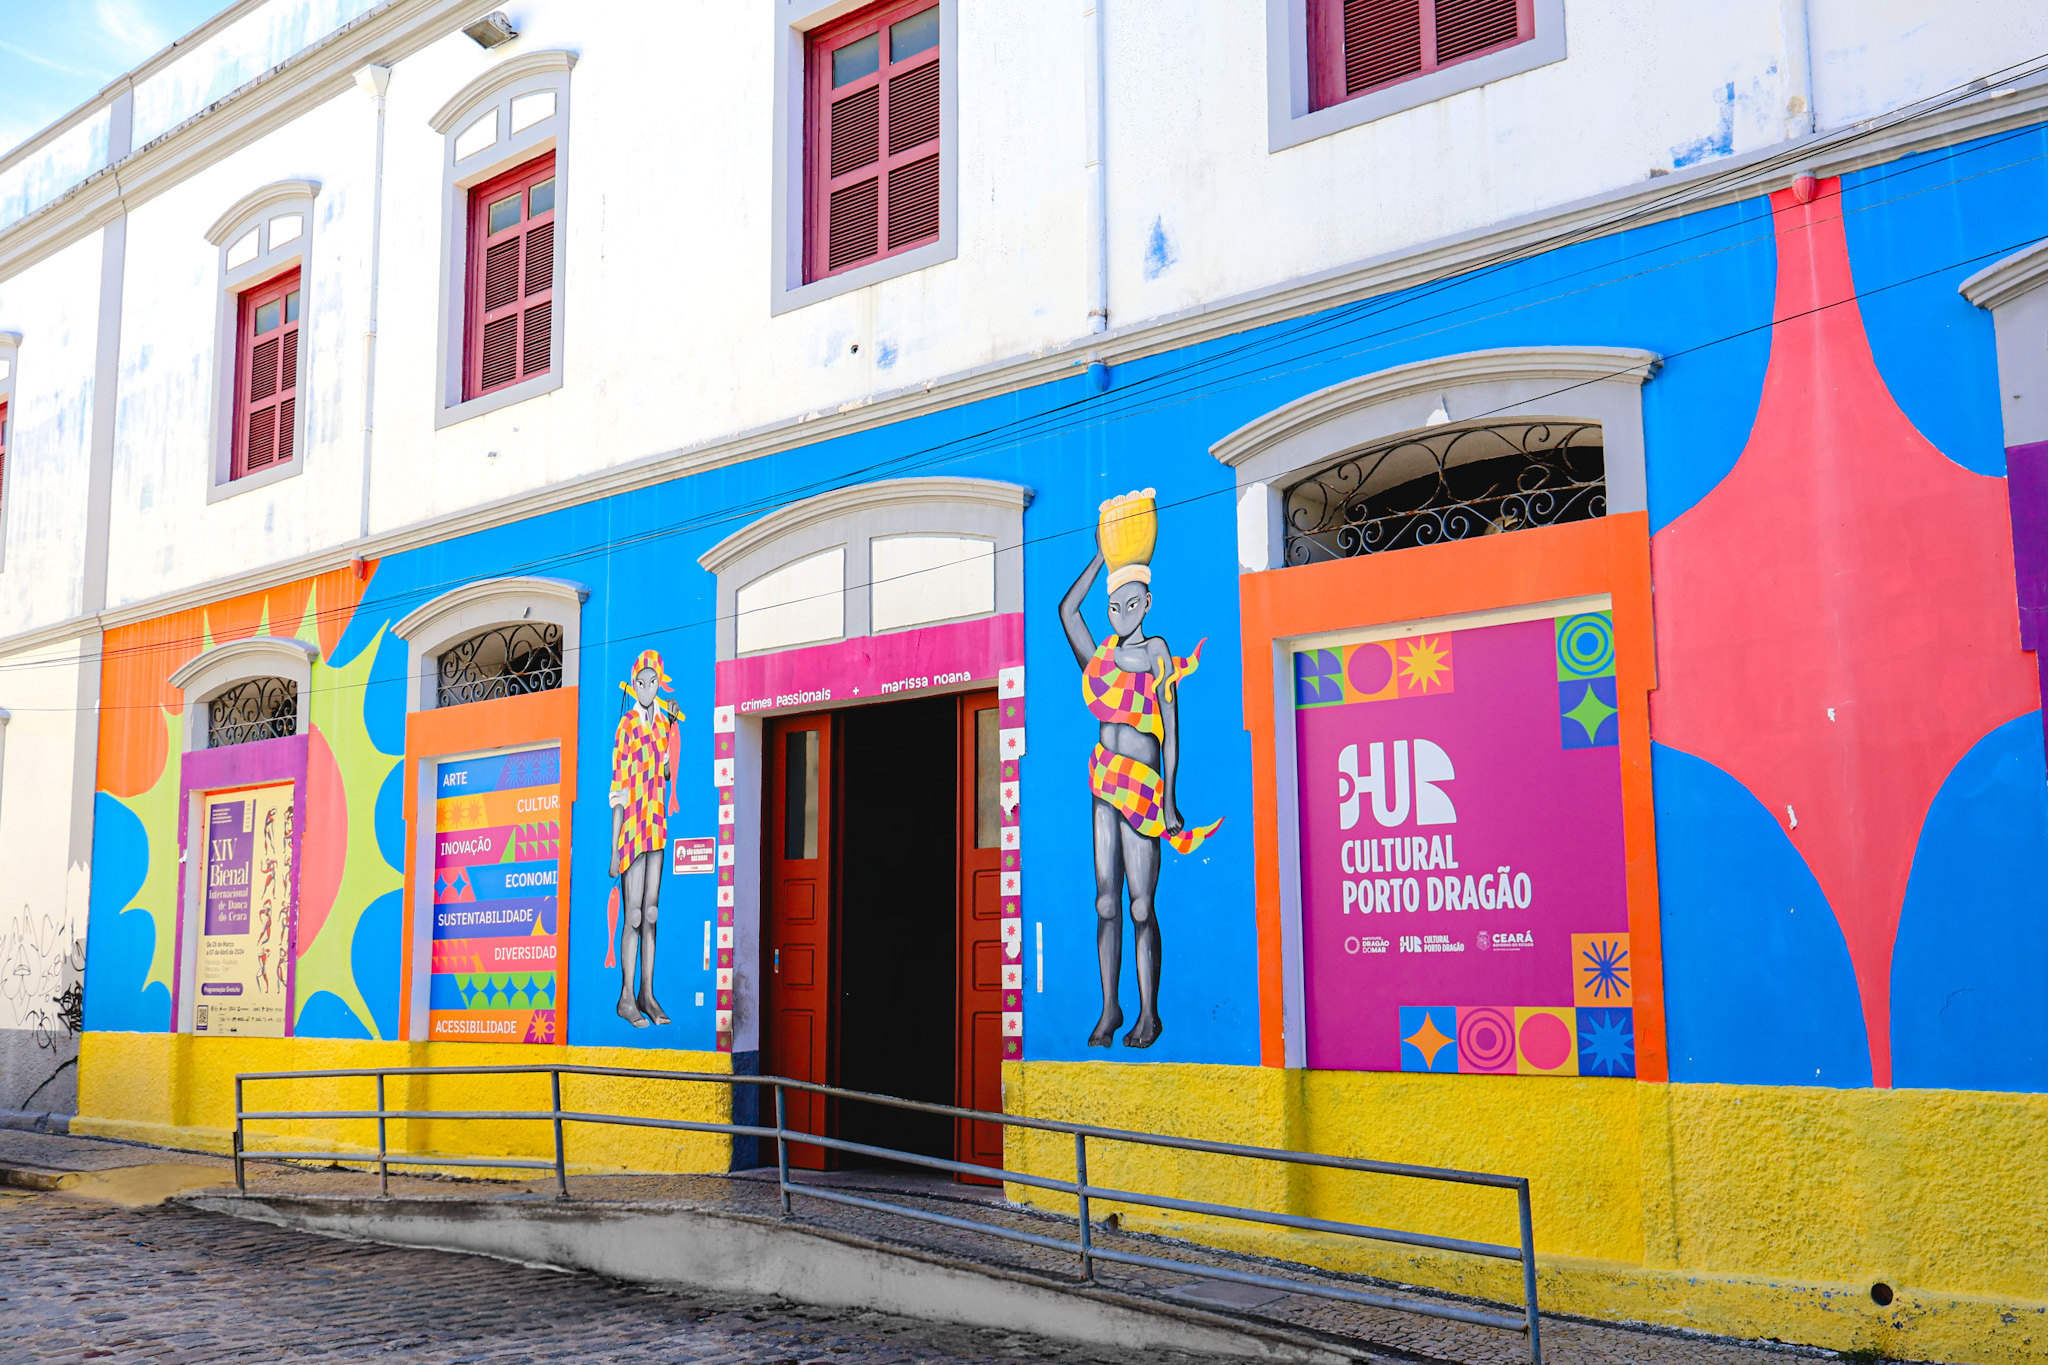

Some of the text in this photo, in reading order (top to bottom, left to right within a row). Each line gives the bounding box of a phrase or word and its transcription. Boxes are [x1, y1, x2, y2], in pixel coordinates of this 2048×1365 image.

[741, 696, 772, 711] crimes
[776, 687, 831, 707] passionais
[881, 675, 928, 694] marissa
[933, 671, 971, 685] noana
[443, 771, 468, 787] ARTE
[210, 837, 238, 862] XIV
[441, 836, 491, 856] INOVAÇÃO
[1341, 834, 1459, 874] CULTURAL
[209, 861, 249, 887] Bienal
[505, 870, 558, 888] ECONOMI
[209, 887, 248, 899] Internacional
[1342, 865, 1532, 914] PORTO DRAGÃO
[218, 900, 247, 911] de Dança
[219, 912, 226, 921] do
[438, 909, 533, 926] SUSTENTABILIDADE
[1362, 939, 1390, 947] DRAGÃO
[1424, 935, 1449, 943] CULTURAL
[1492, 930, 1534, 943] CEARÁ
[494, 946, 557, 960] DIVERSIDAD
[1424, 941, 1465, 952] PORTO DRAGÃO
[435, 1020, 517, 1033] ACESSIBILIDADE
